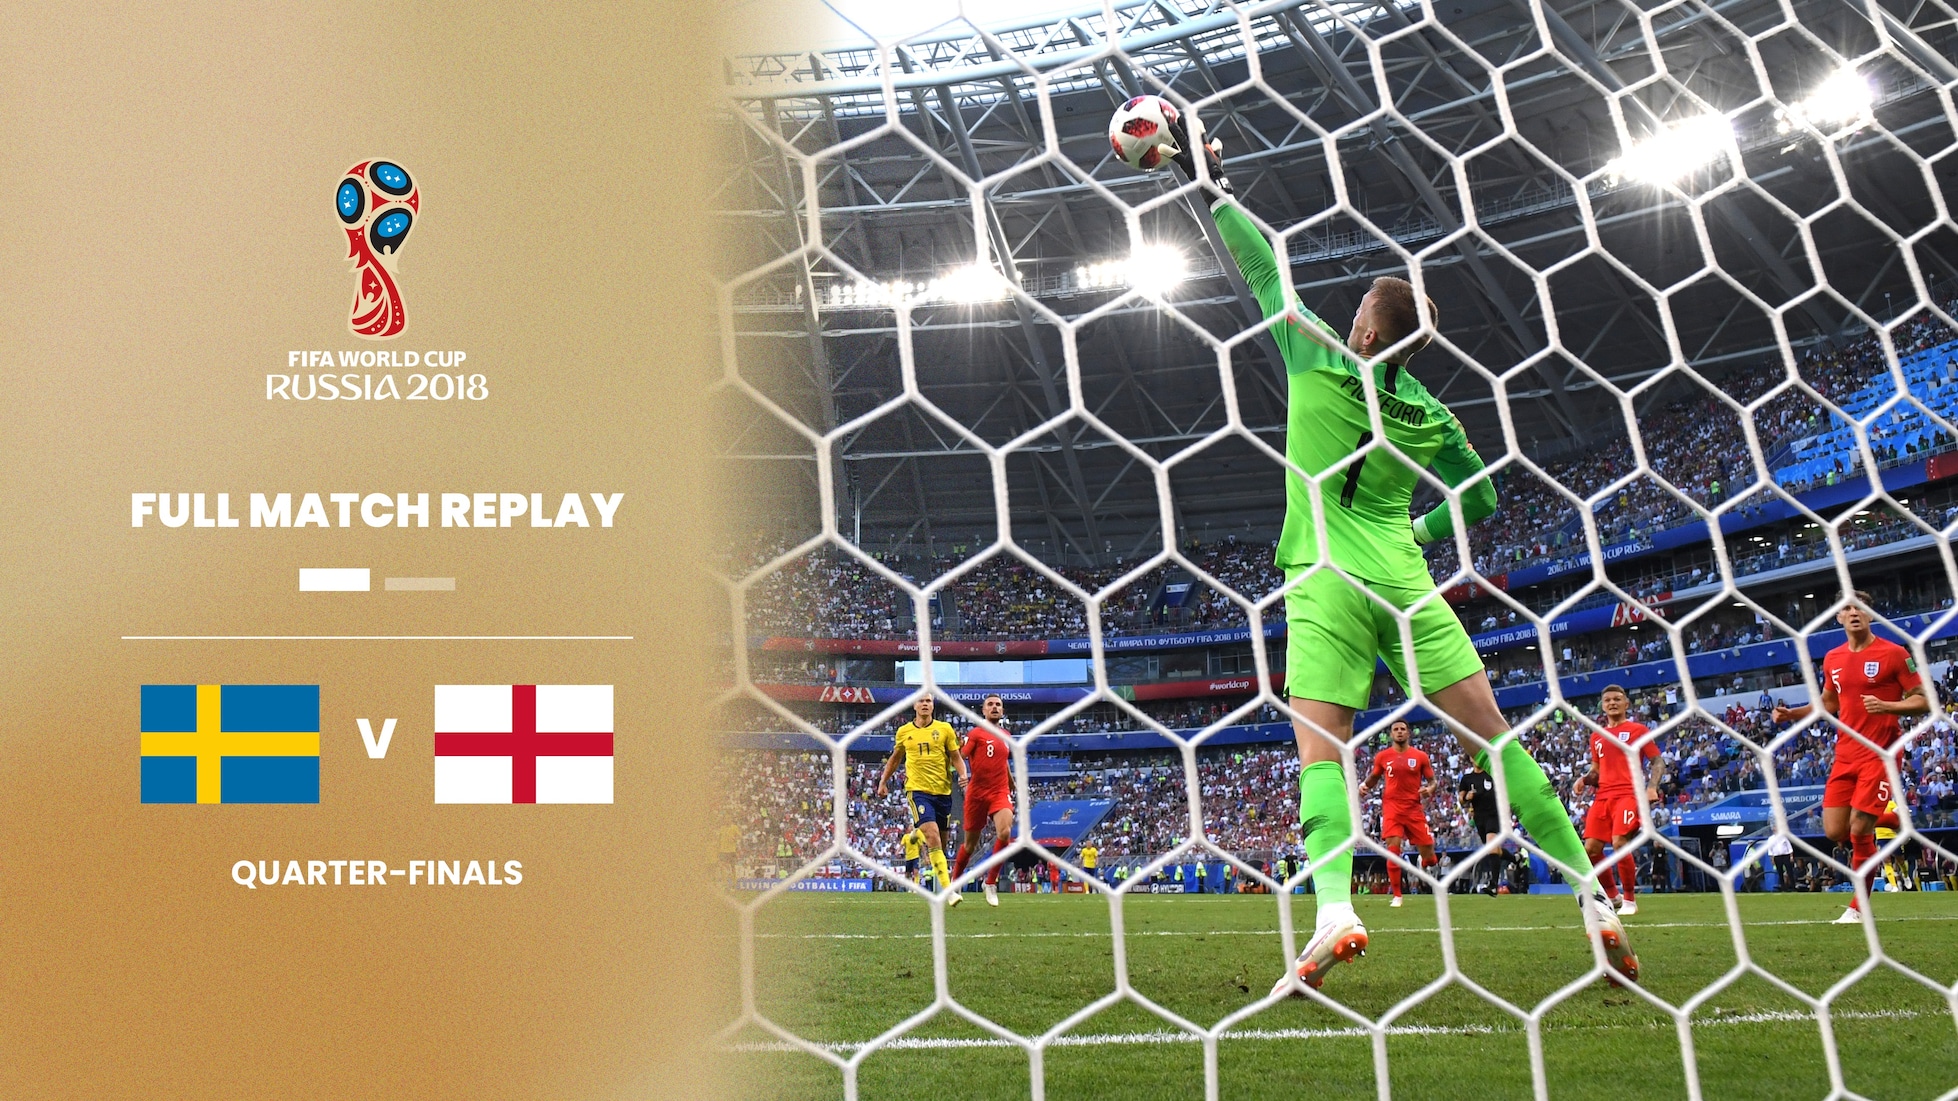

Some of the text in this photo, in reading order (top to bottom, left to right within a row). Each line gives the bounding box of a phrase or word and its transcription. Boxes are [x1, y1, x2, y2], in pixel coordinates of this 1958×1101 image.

[1340, 431, 1374, 509] 1
[1580, 551, 1606, 566] WOD
[1607, 546, 1623, 559] CUP
[1068, 641, 1117, 650] ЧЕМПНАТ
[1120, 639, 1143, 647] МИРА
[1144, 638, 1156, 646] ПО
[1158, 636, 1195, 645] ФУТБОЛУ
[1197, 635, 1213, 643] FIFA
[1214, 633, 1231, 641] 2018
[1473, 636, 1499, 648] УТБОЛУ
[1515, 629, 1531, 640] 2018
[898, 643, 941, 653] #worup
[1209, 680, 1249, 691] #worldcup
[1832, 674, 1842, 694] 5
[1000, 692, 1032, 701] RUSSIA
[986, 744, 994, 758] 8
[1386, 765, 1394, 778] 2
[1877, 780, 1890, 802] 5
[1710, 811, 1742, 821] SAMARA
[790, 881, 838, 890] OOTBALL
[848, 882, 867, 890] FIFA
